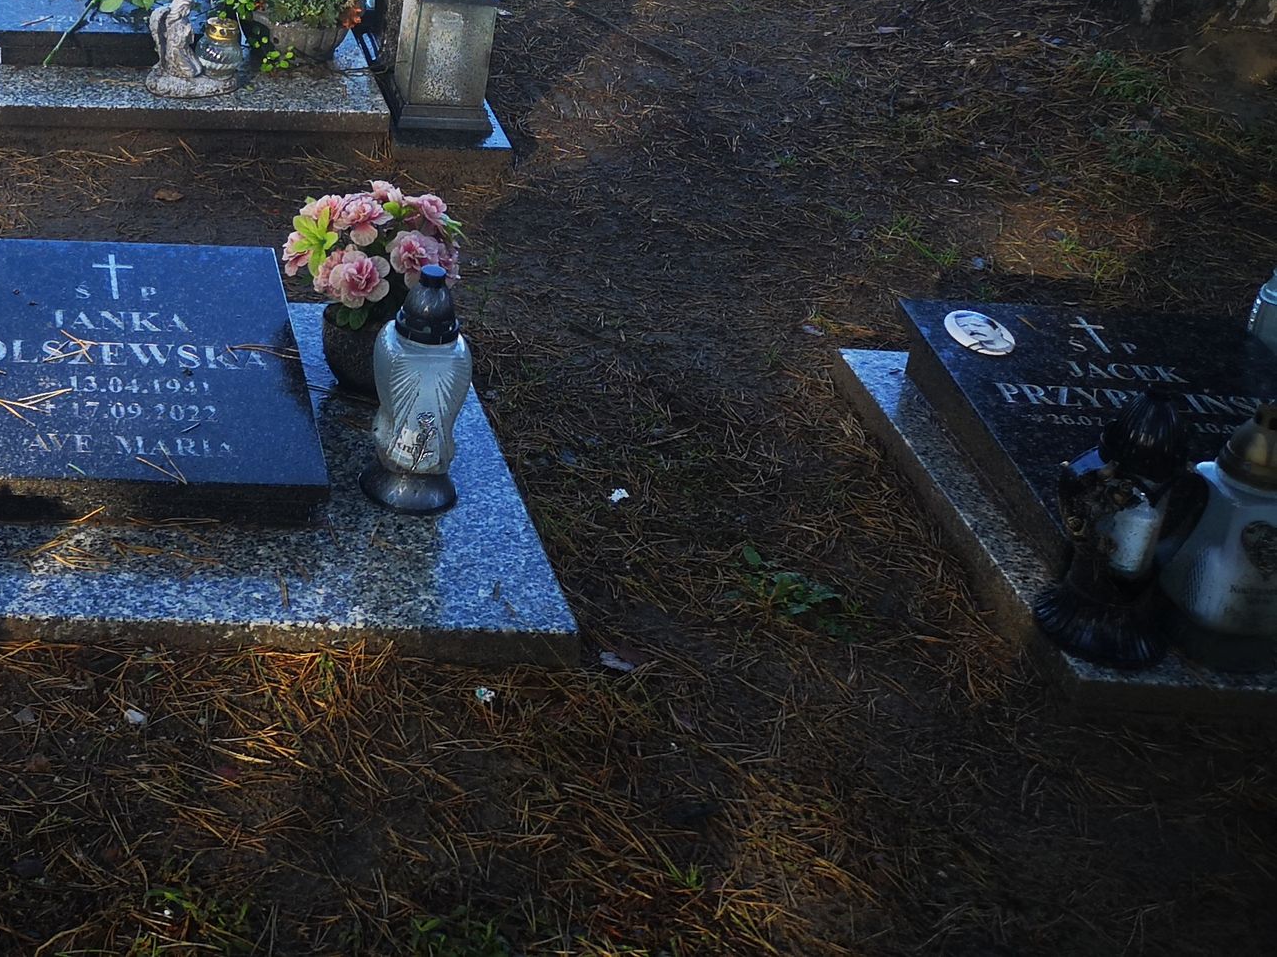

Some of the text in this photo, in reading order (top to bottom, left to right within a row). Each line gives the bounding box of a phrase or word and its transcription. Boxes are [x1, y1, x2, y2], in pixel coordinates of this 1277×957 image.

[53, 309, 193, 333] JANKA
[1066, 360, 1191, 384] JACEK
[25, 433, 235, 457] AVE MARIA
